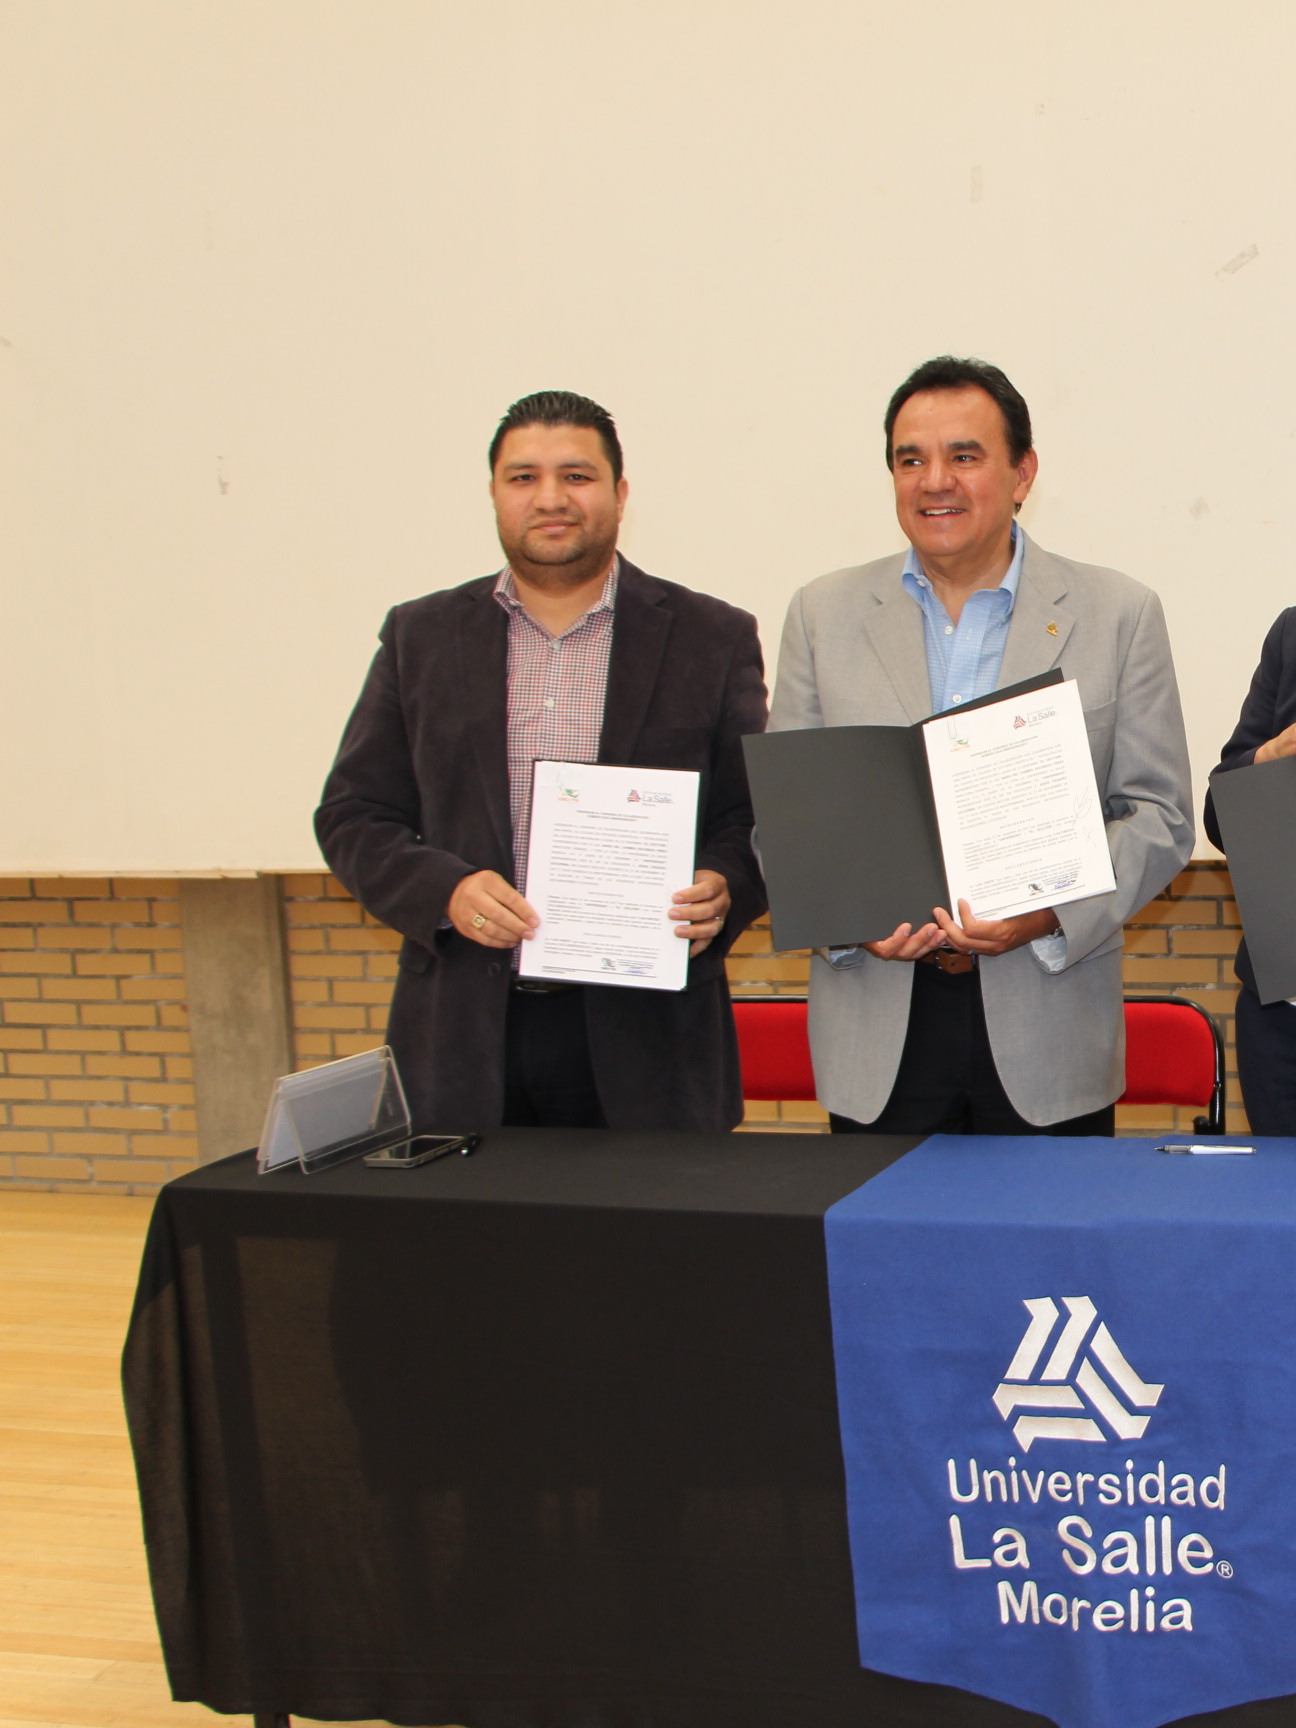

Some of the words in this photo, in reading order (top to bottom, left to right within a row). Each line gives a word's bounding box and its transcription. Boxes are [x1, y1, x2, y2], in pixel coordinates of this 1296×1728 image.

[947, 1456, 1226, 1511] Universidad
[948, 1513, 1031, 1570] La
[998, 1580, 1193, 1633] Morelia
